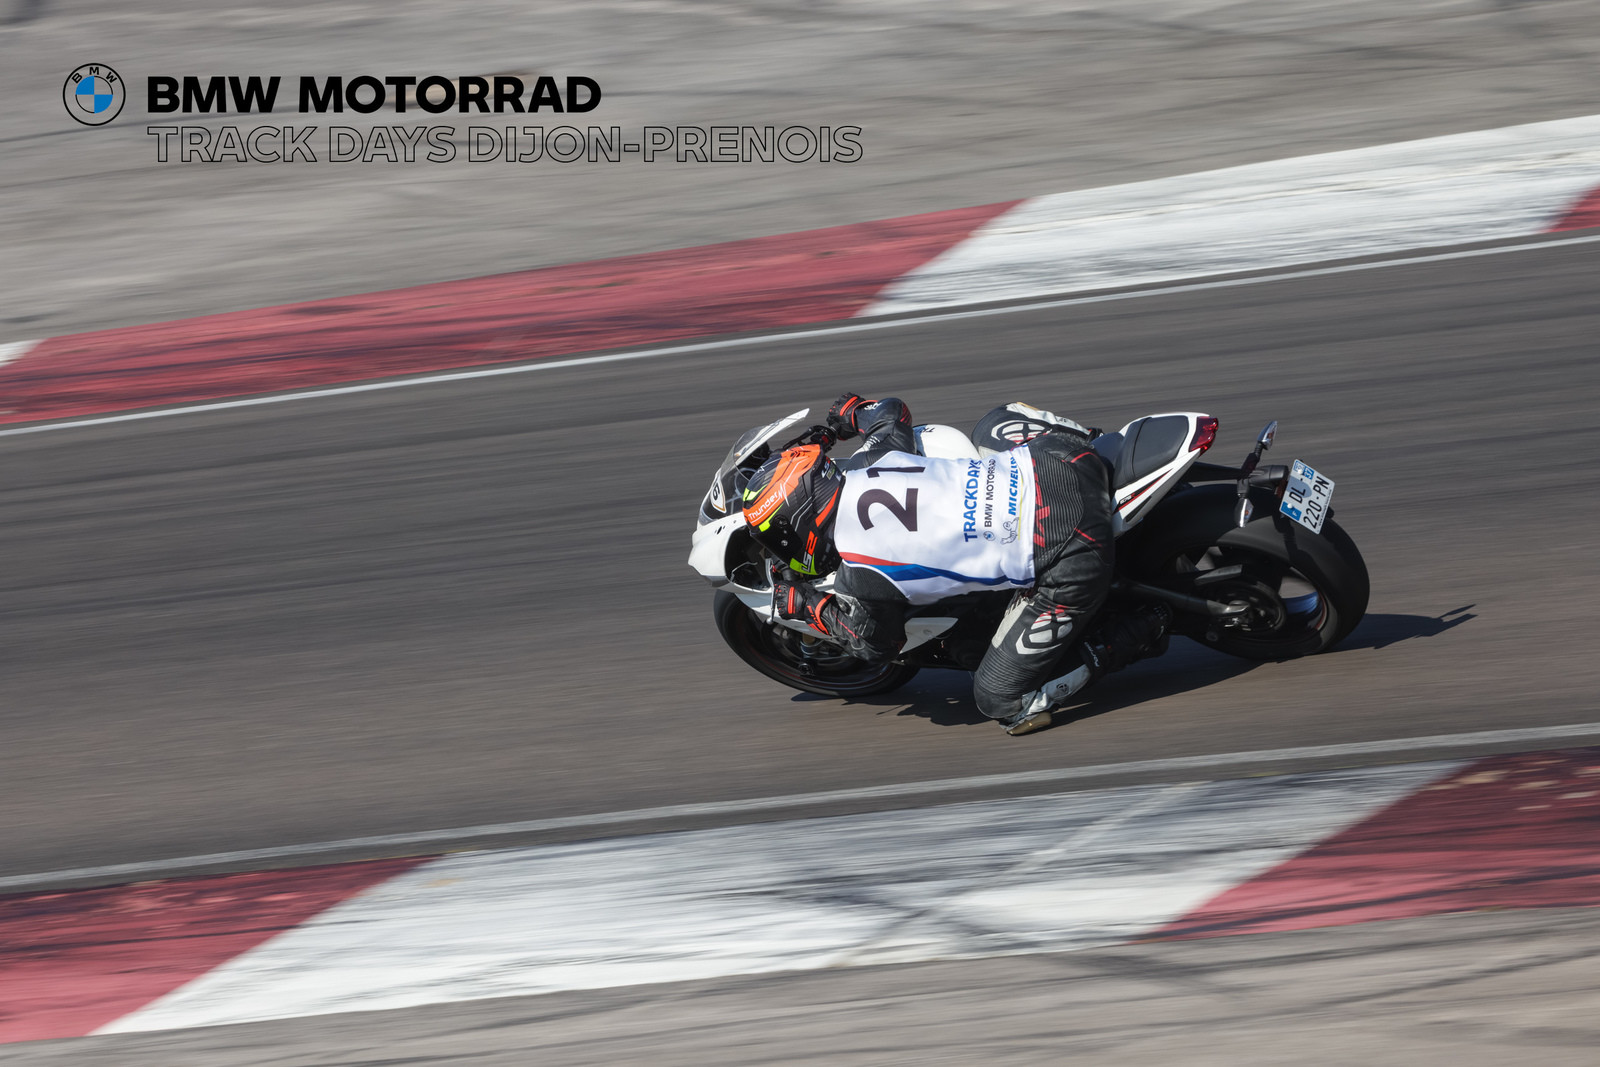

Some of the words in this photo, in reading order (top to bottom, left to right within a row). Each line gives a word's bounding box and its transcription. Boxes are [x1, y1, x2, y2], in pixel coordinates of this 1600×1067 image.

[857, 466, 925, 532] 21
[963, 459, 982, 542] TRACKDAYS
[986, 459, 996, 501] MOTORRAD
[1008, 456, 1019, 516] MICHELIN
[748, 492, 778, 521] Thunder
[984, 504, 993, 528] BMW
[802, 531, 818, 572] LS2
